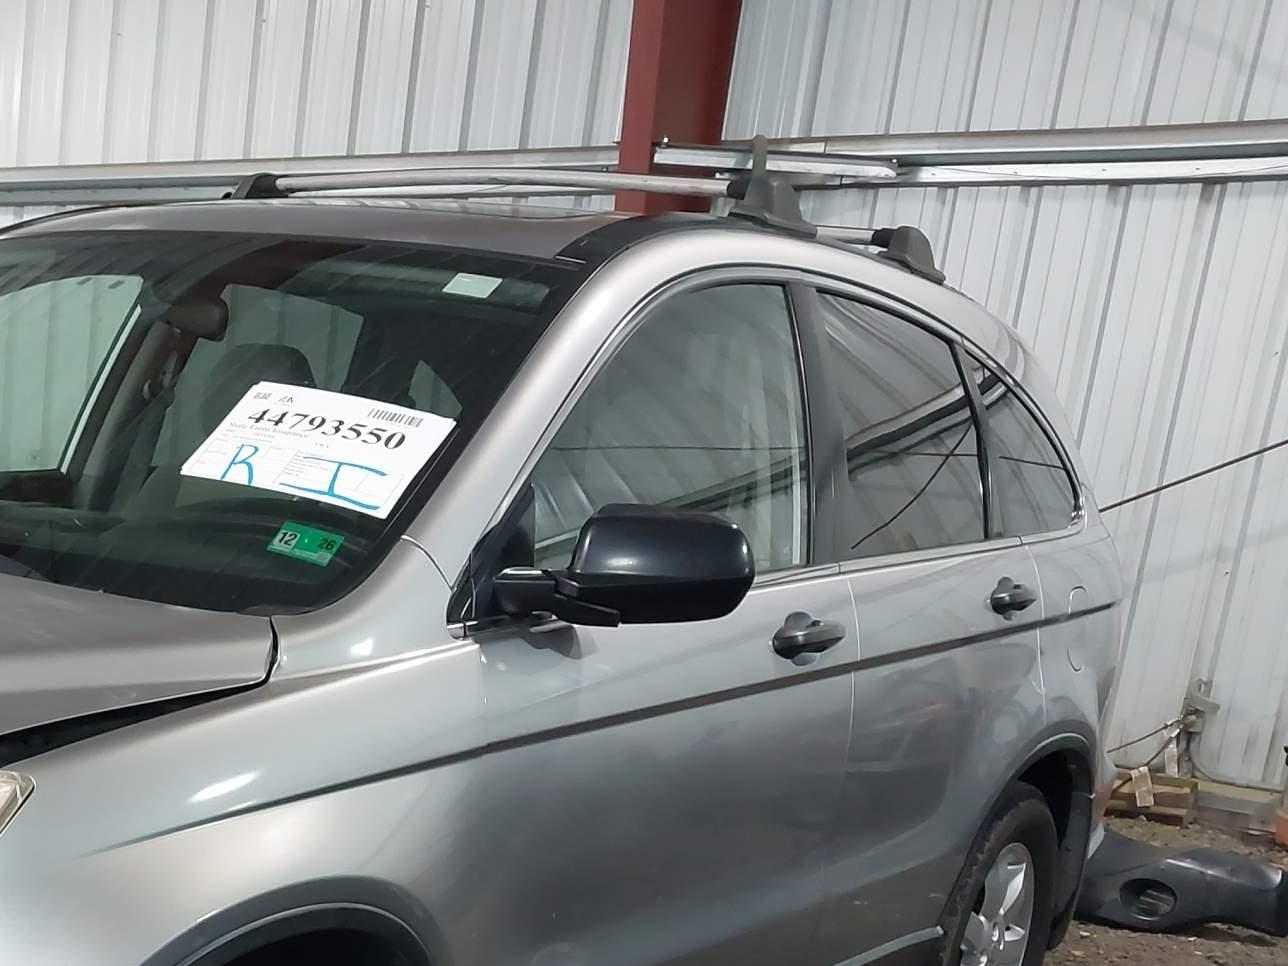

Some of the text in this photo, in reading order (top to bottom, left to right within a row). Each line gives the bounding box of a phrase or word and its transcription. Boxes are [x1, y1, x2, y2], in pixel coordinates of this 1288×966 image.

[247, 408, 406, 451] 44793550
[220, 443, 260, 486] R
[278, 531, 337, 551] 12 26
